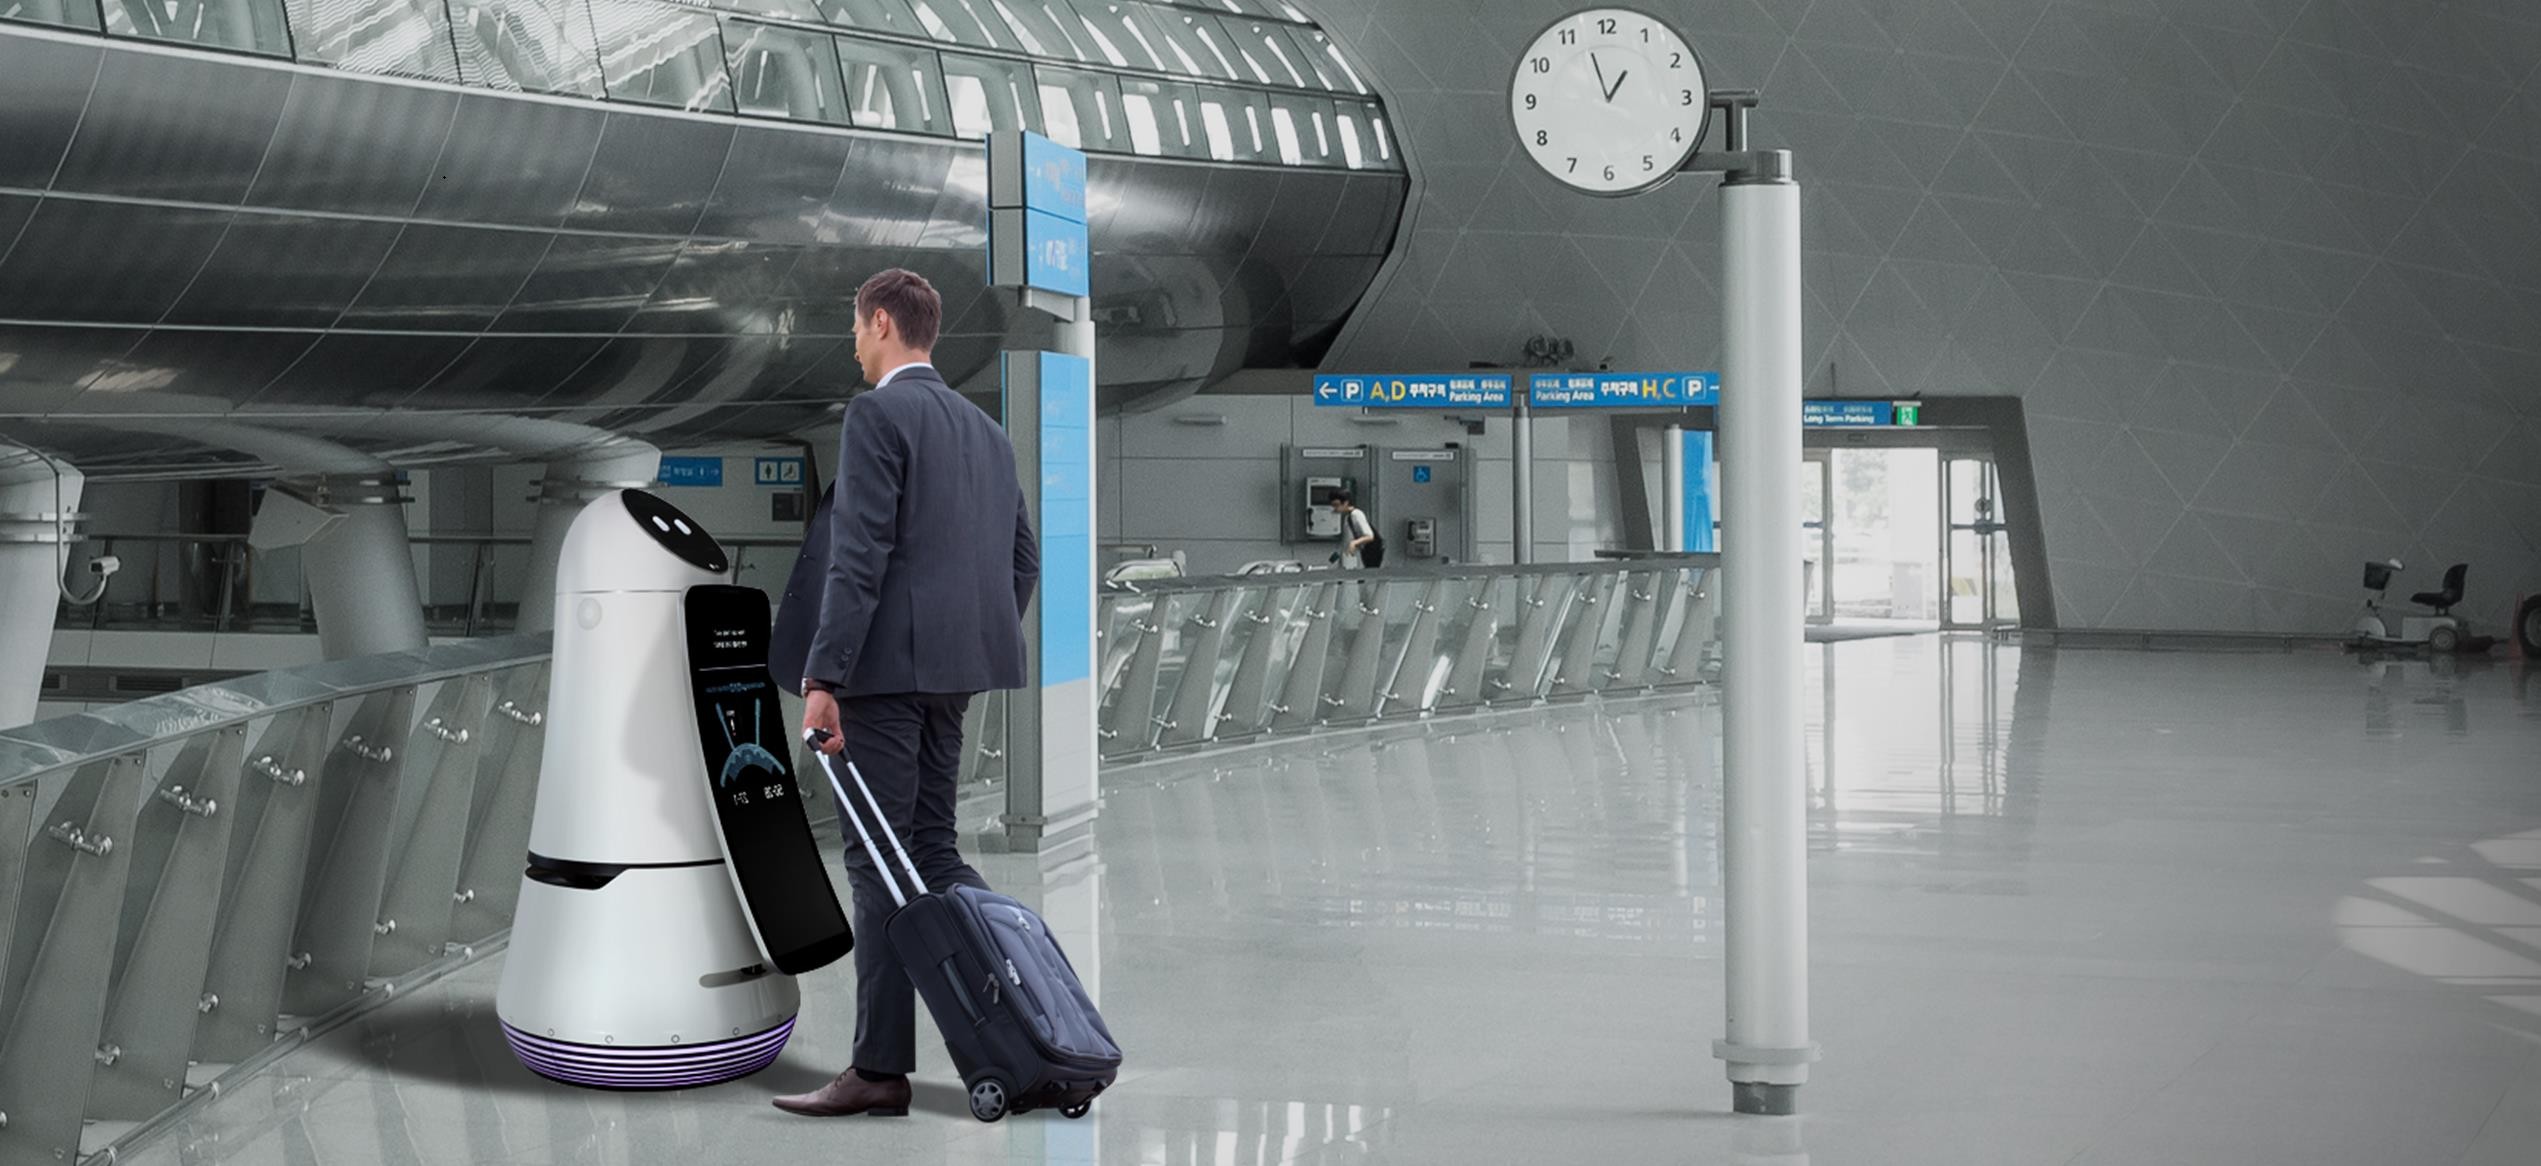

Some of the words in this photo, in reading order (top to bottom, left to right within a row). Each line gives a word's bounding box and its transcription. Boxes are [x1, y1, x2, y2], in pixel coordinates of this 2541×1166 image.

[1597, 18, 1616, 35] 12
[1558, 29, 1575, 45] 11
[1640, 28, 1648, 43] 1
[1530, 57, 1550, 73] 10
[1670, 52, 1681, 68] 2
[1525, 94, 1536, 110] 9
[1682, 89, 1692, 106] 3
[1536, 130, 1548, 146] 8
[1671, 127, 1681, 143] 4
[1567, 157, 1577, 173] 7
[1643, 155, 1653, 171] 5
[1604, 165, 1614, 181] 6
[1370, 381, 1406, 402] A,D
[1449, 391, 1482, 403] Parking
[1483, 391, 1504, 402] Area
[1535, 390, 1570, 403] Parking
[1572, 390, 1595, 401] Area
[1642, 379, 1676, 400] H,C
[1804, 414, 1824, 425] Long
[1825, 414, 1844, 423] Term
[1845, 414, 1875, 425] Parking
